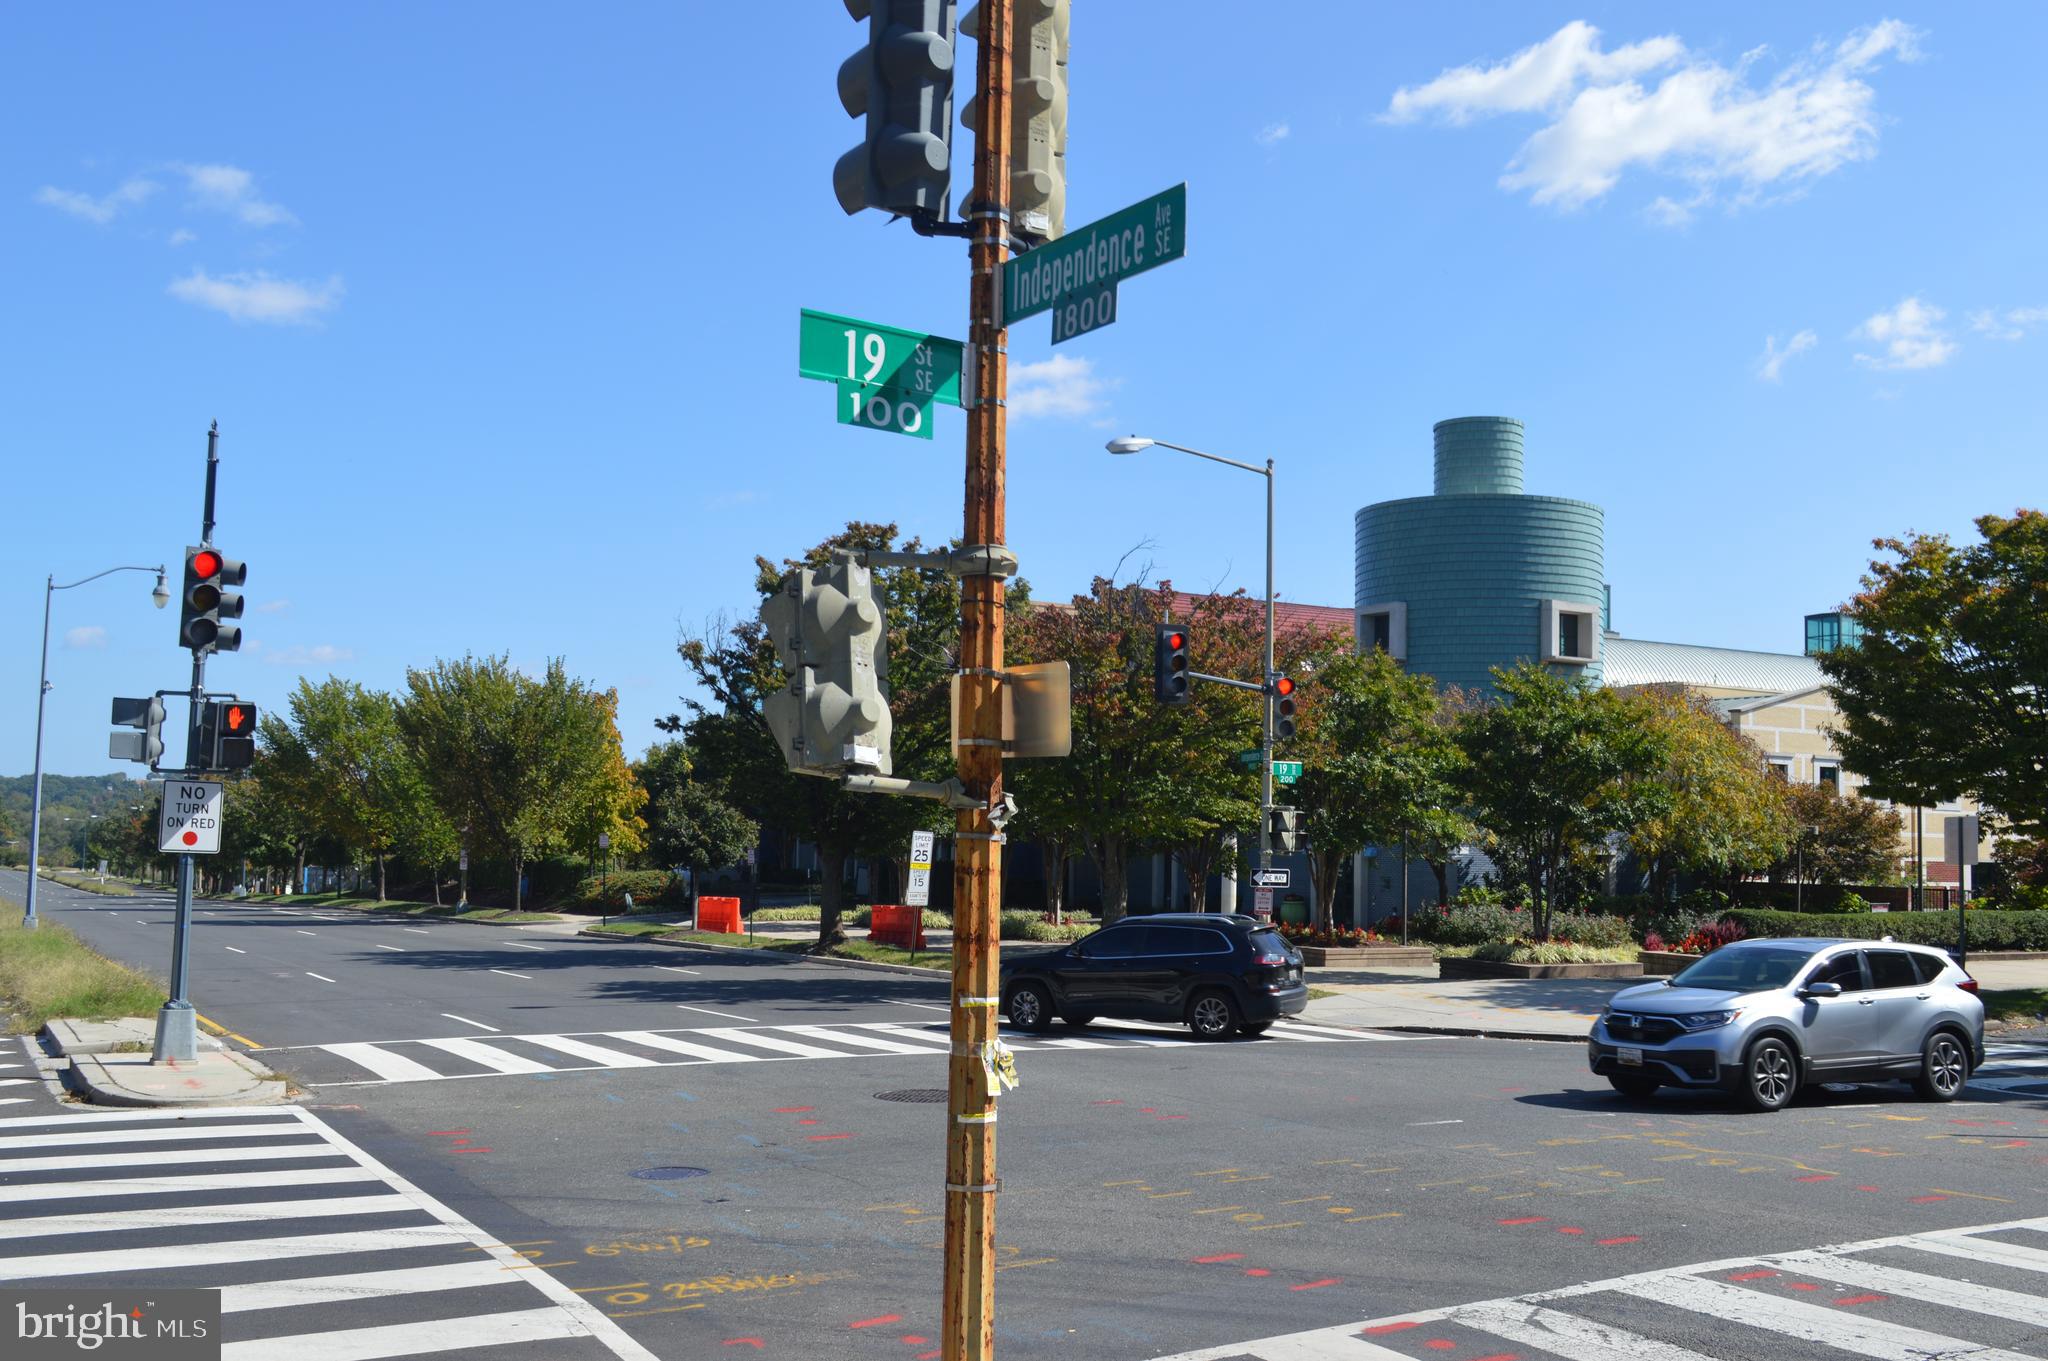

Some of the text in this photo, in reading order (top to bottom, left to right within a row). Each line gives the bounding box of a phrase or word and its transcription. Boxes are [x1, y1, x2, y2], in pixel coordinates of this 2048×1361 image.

[1155, 202, 1172, 229] Ave
[1154, 230, 1171, 258] SE
[1013, 222, 1145, 312] Independence
[1054, 289, 1113, 341] 1800
[844, 329, 886, 382] 19
[914, 343, 933, 368] St
[914, 369, 934, 393] SE
[849, 391, 922, 433] 100
[1279, 763, 1288, 775] 19
[1280, 775, 1294, 784] 200
[181, 786, 205, 799] NO
[176, 803, 209, 814] TURN
[167, 816, 215, 829] ON RED
[913, 849, 929, 862] 25
[913, 878, 925, 887] 15
